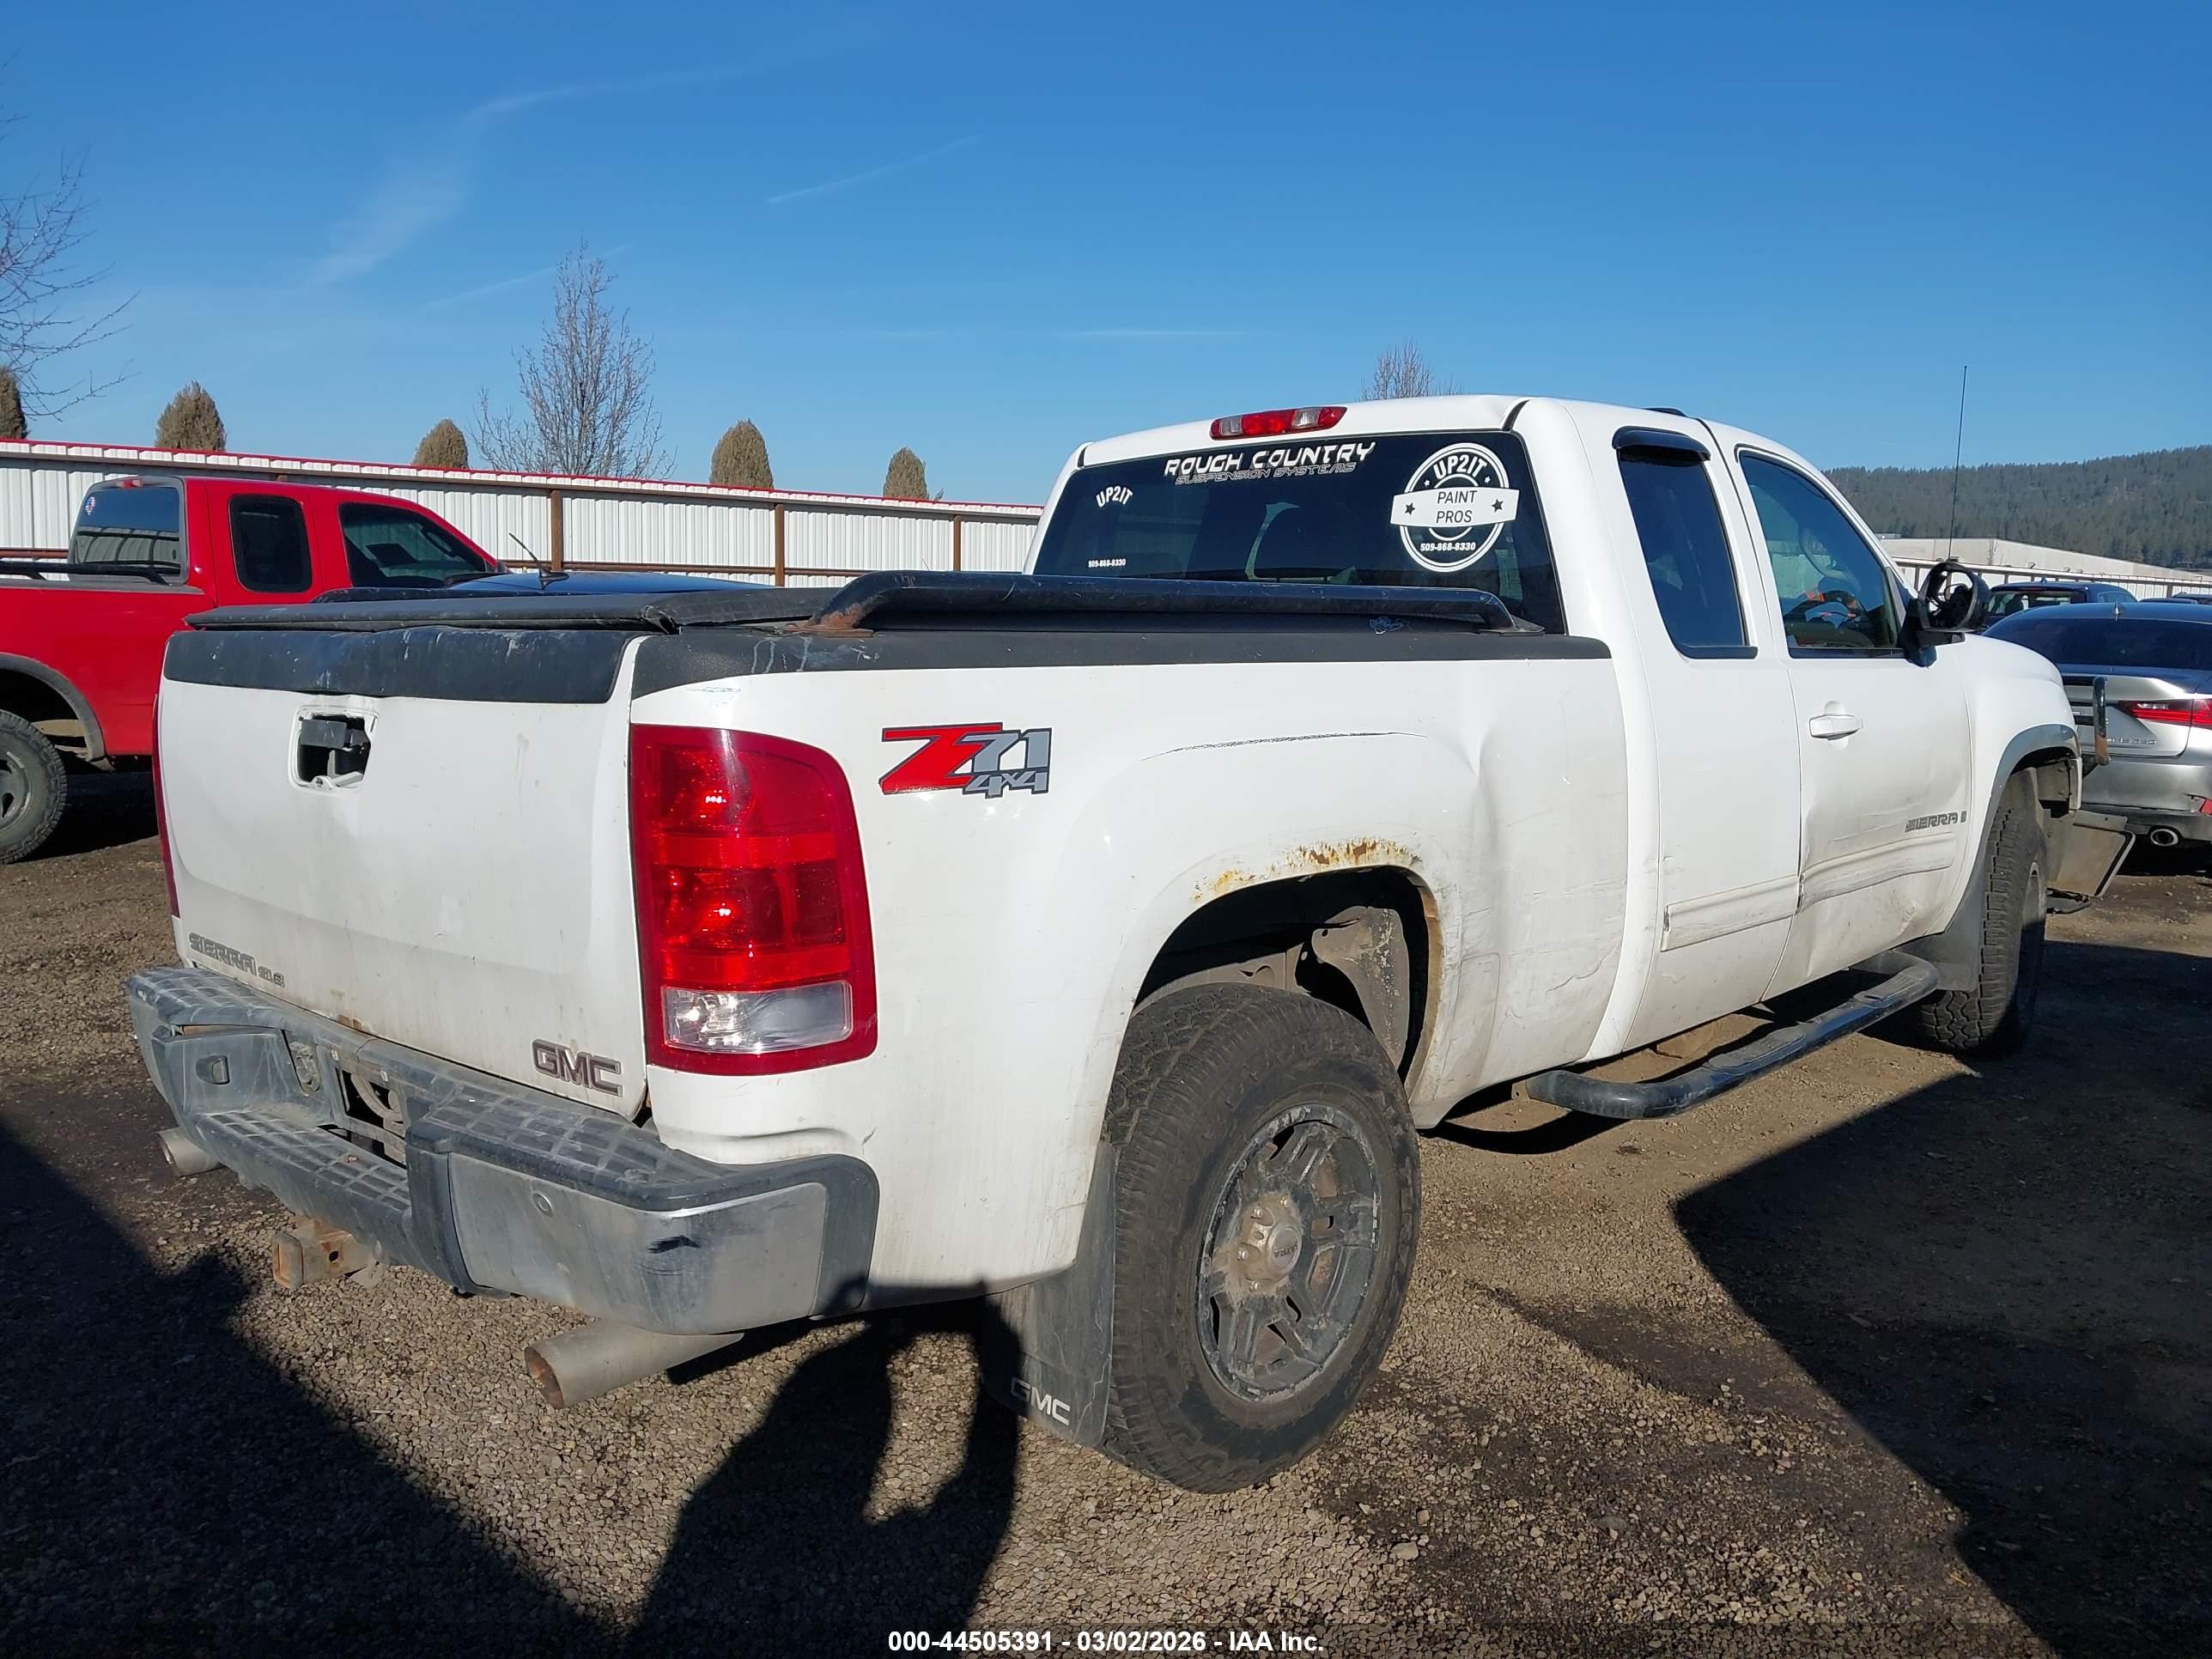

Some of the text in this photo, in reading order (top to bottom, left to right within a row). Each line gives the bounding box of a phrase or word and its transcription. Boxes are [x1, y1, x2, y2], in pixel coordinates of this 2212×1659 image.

[1164, 441, 1376, 476] ROUGH COUNTRY
[1432, 454, 1488, 479] UP2IT
[1176, 461, 1358, 485] SUSPENSION SYSTEMS
[1096, 485, 1133, 507] UP2IT
[1437, 489, 1478, 504] PAINT
[1436, 510, 1473, 524] PROS
[1419, 542, 1477, 551] 509-868-8330
[878, 721, 1053, 795] Z71
[1905, 811, 1959, 833] SIERRA
[188, 932, 258, 976] SIERRA
[532, 1038, 623, 1097] GMC
[1011, 1376, 1072, 1426] GMC
